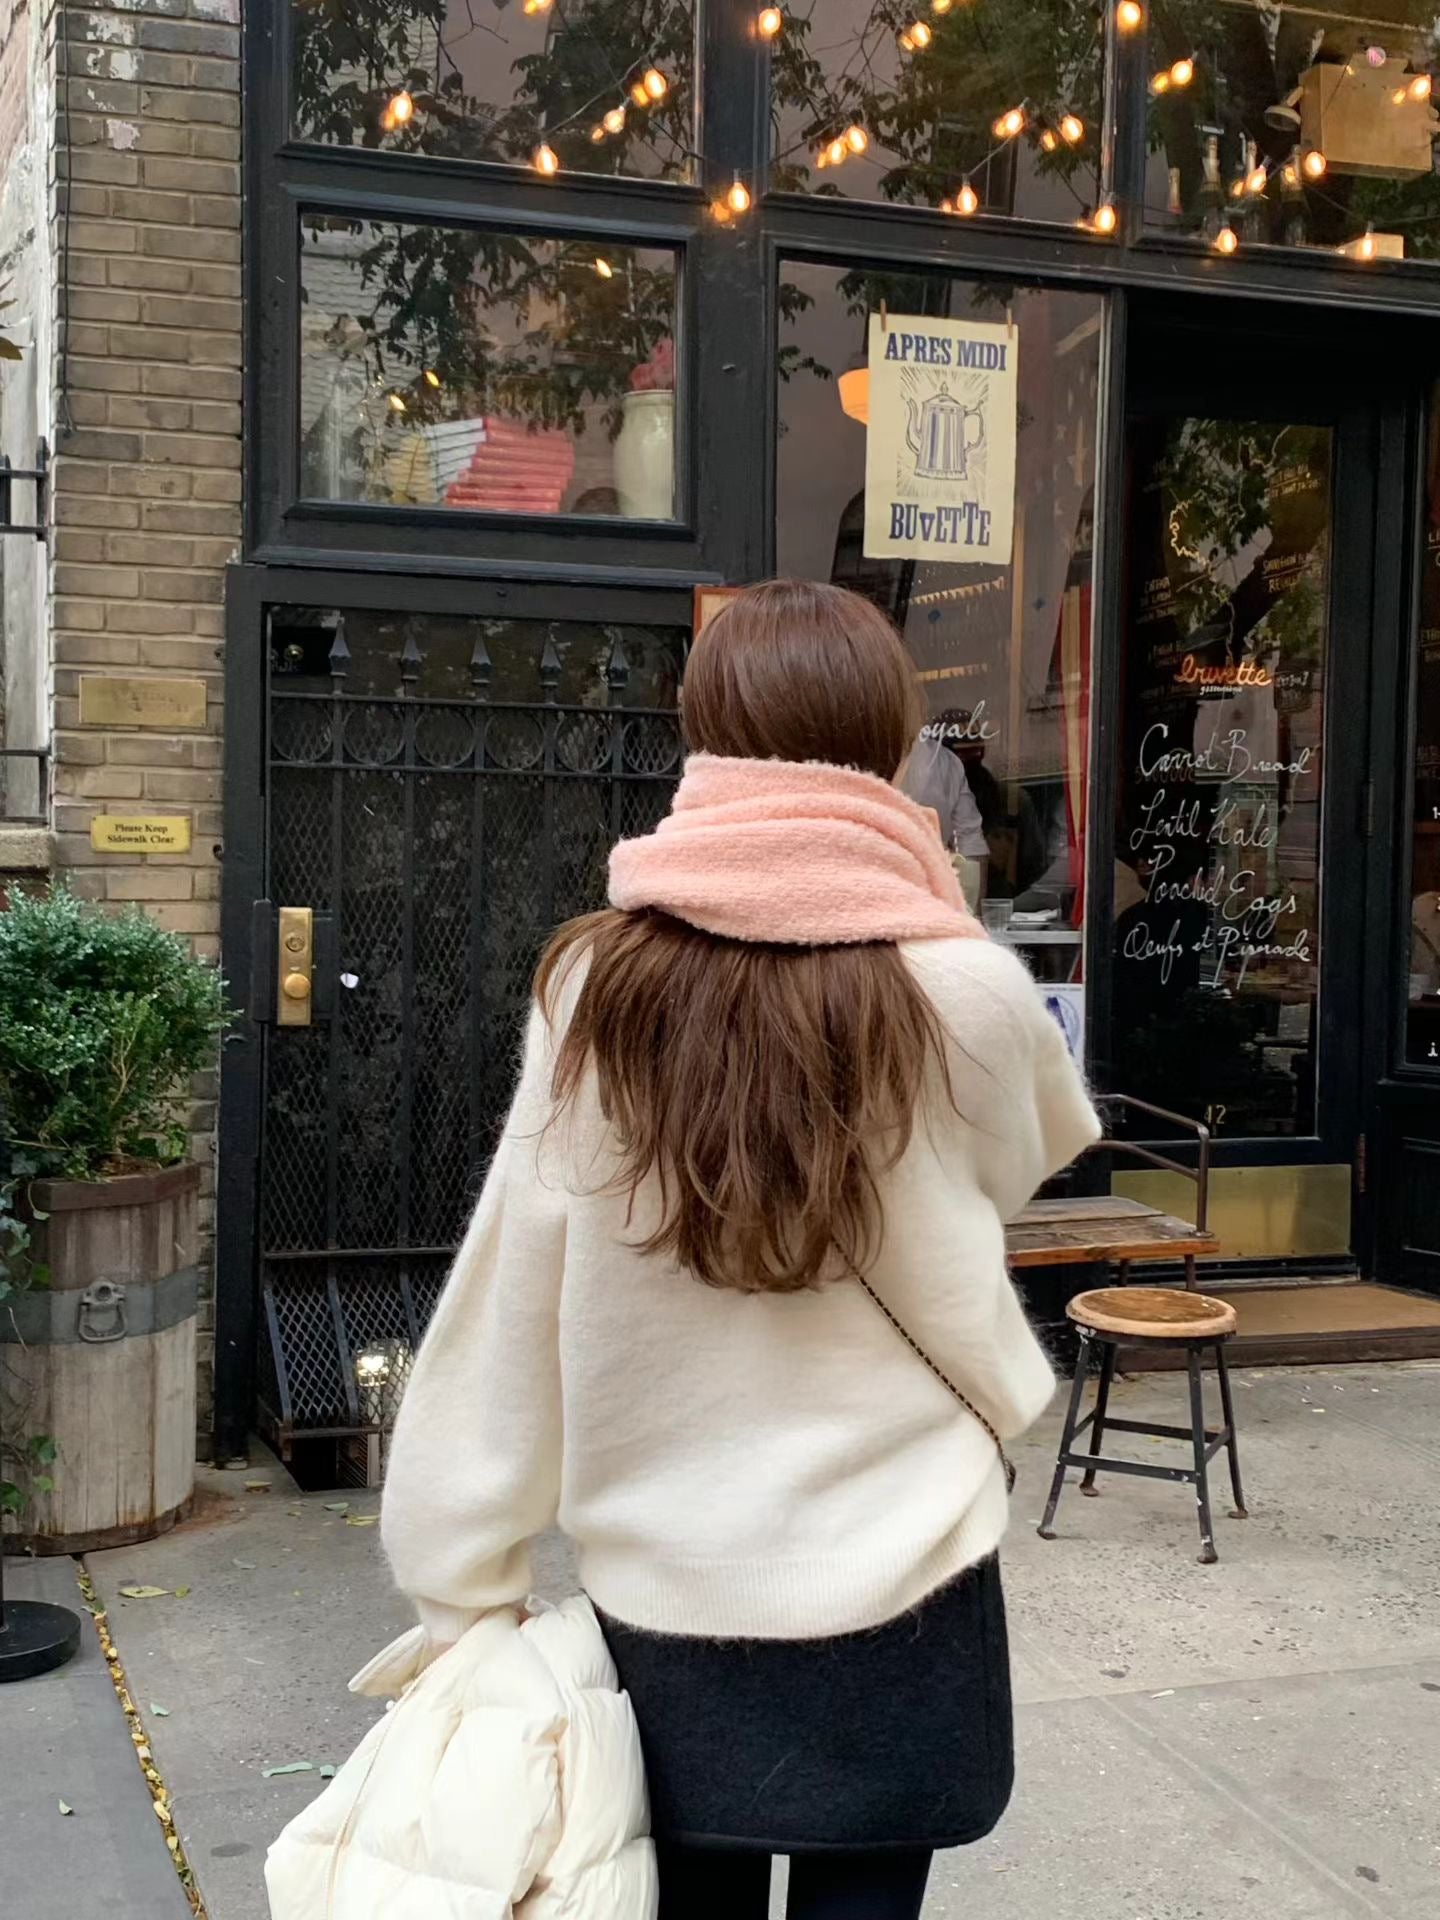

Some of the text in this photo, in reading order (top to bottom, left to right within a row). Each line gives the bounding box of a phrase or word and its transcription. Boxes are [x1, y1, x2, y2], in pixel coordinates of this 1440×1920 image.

[884, 332, 1007, 371] APRES MIDI
[889, 502, 991, 546] BUVETTE
[919, 699, 1000, 769] oyale
[1140, 723, 1312, 784] Carrot Bread
[107, 834, 175, 844] Sidewalk Clear
[115, 823, 168, 835] Please Keep
[1130, 788, 1276, 850] Lentil Kale
[1222, 870, 1297, 939] Eggs
